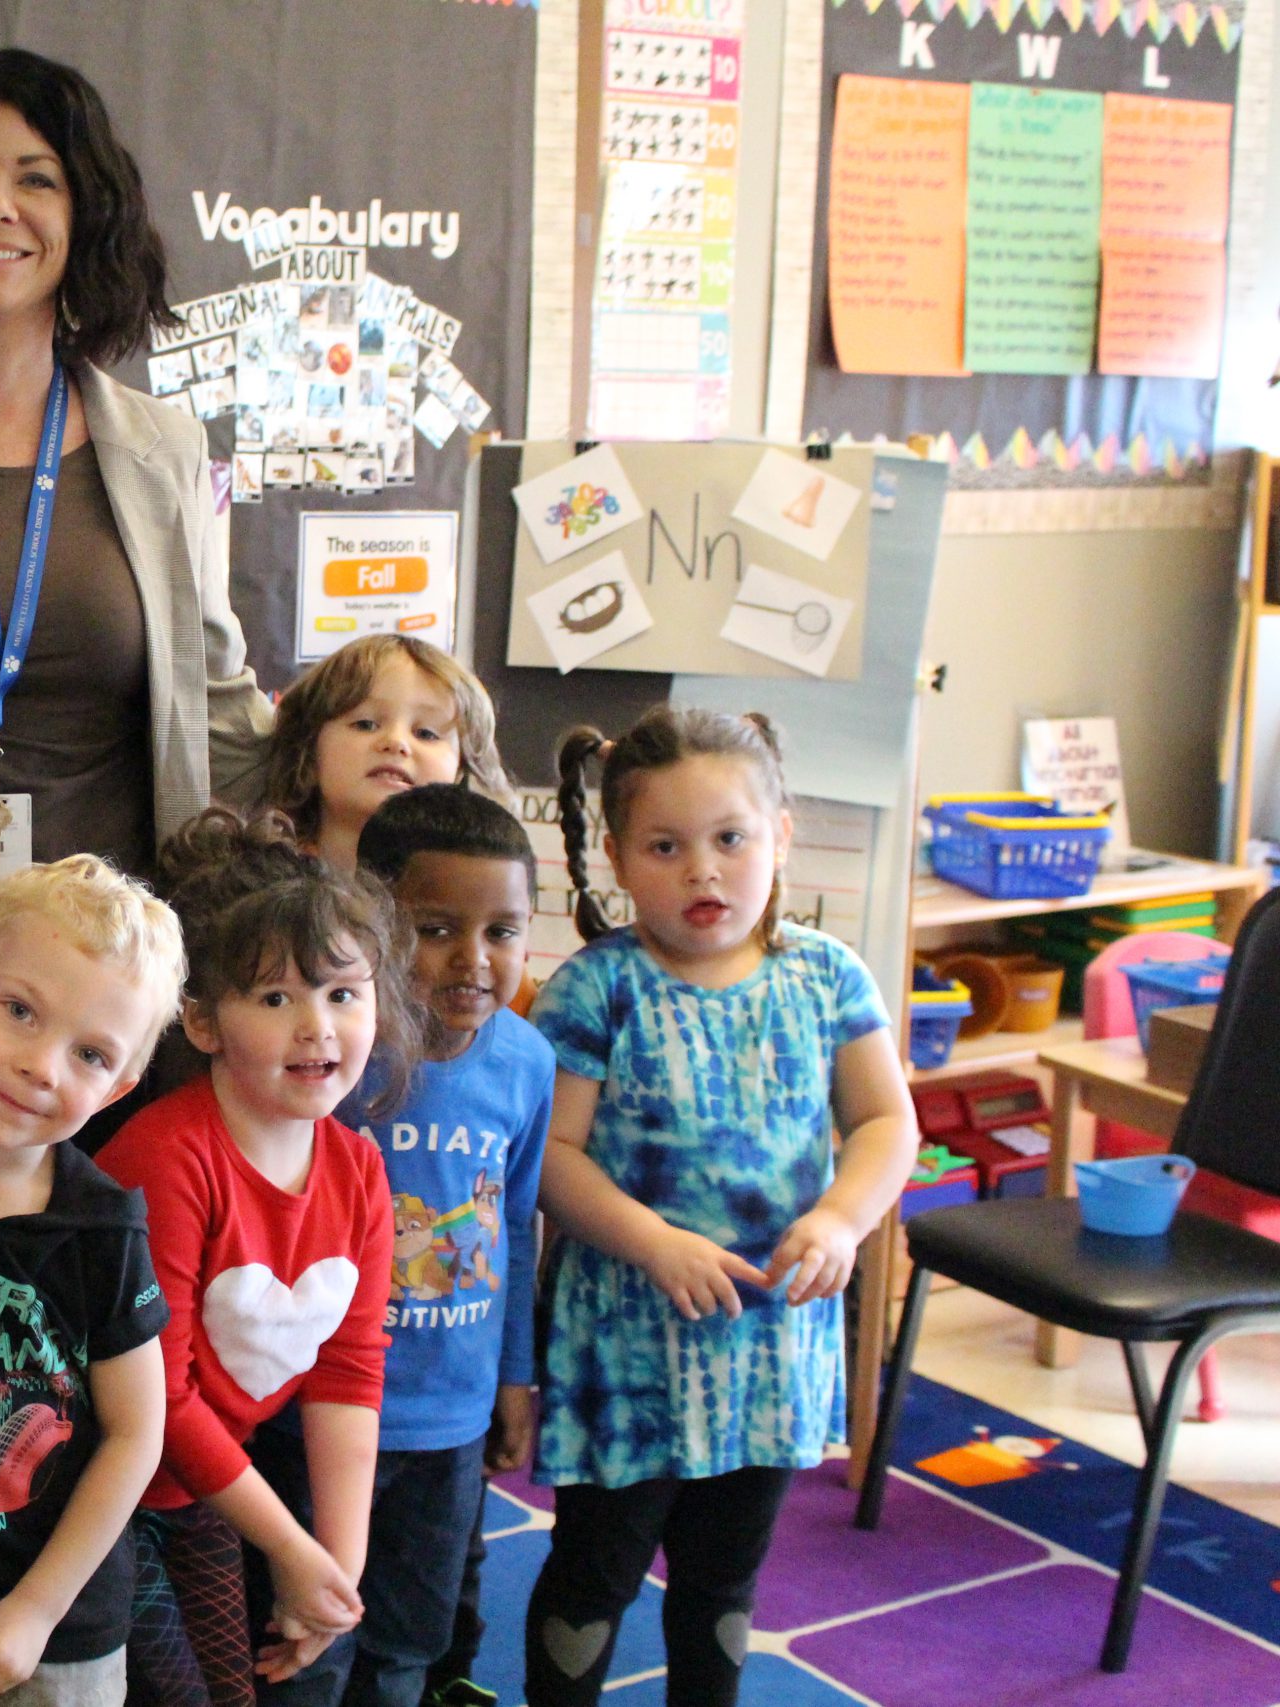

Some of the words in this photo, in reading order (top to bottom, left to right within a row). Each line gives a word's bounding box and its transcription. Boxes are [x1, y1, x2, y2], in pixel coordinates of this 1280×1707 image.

[714, 55, 736, 83] 10
[900, 20, 936, 70] K
[1018, 33, 1061, 79] W
[1143, 46, 1170, 89] L
[709, 125, 735, 150] 20
[287, 250, 360, 282] ABOUT
[327, 536, 355, 553] The
[360, 539, 414, 553] season
[420, 536, 431, 552] is
[647, 492, 741, 585] Nn
[358, 563, 396, 590] Fall
[382, 1298, 491, 1328] SITIVITY
